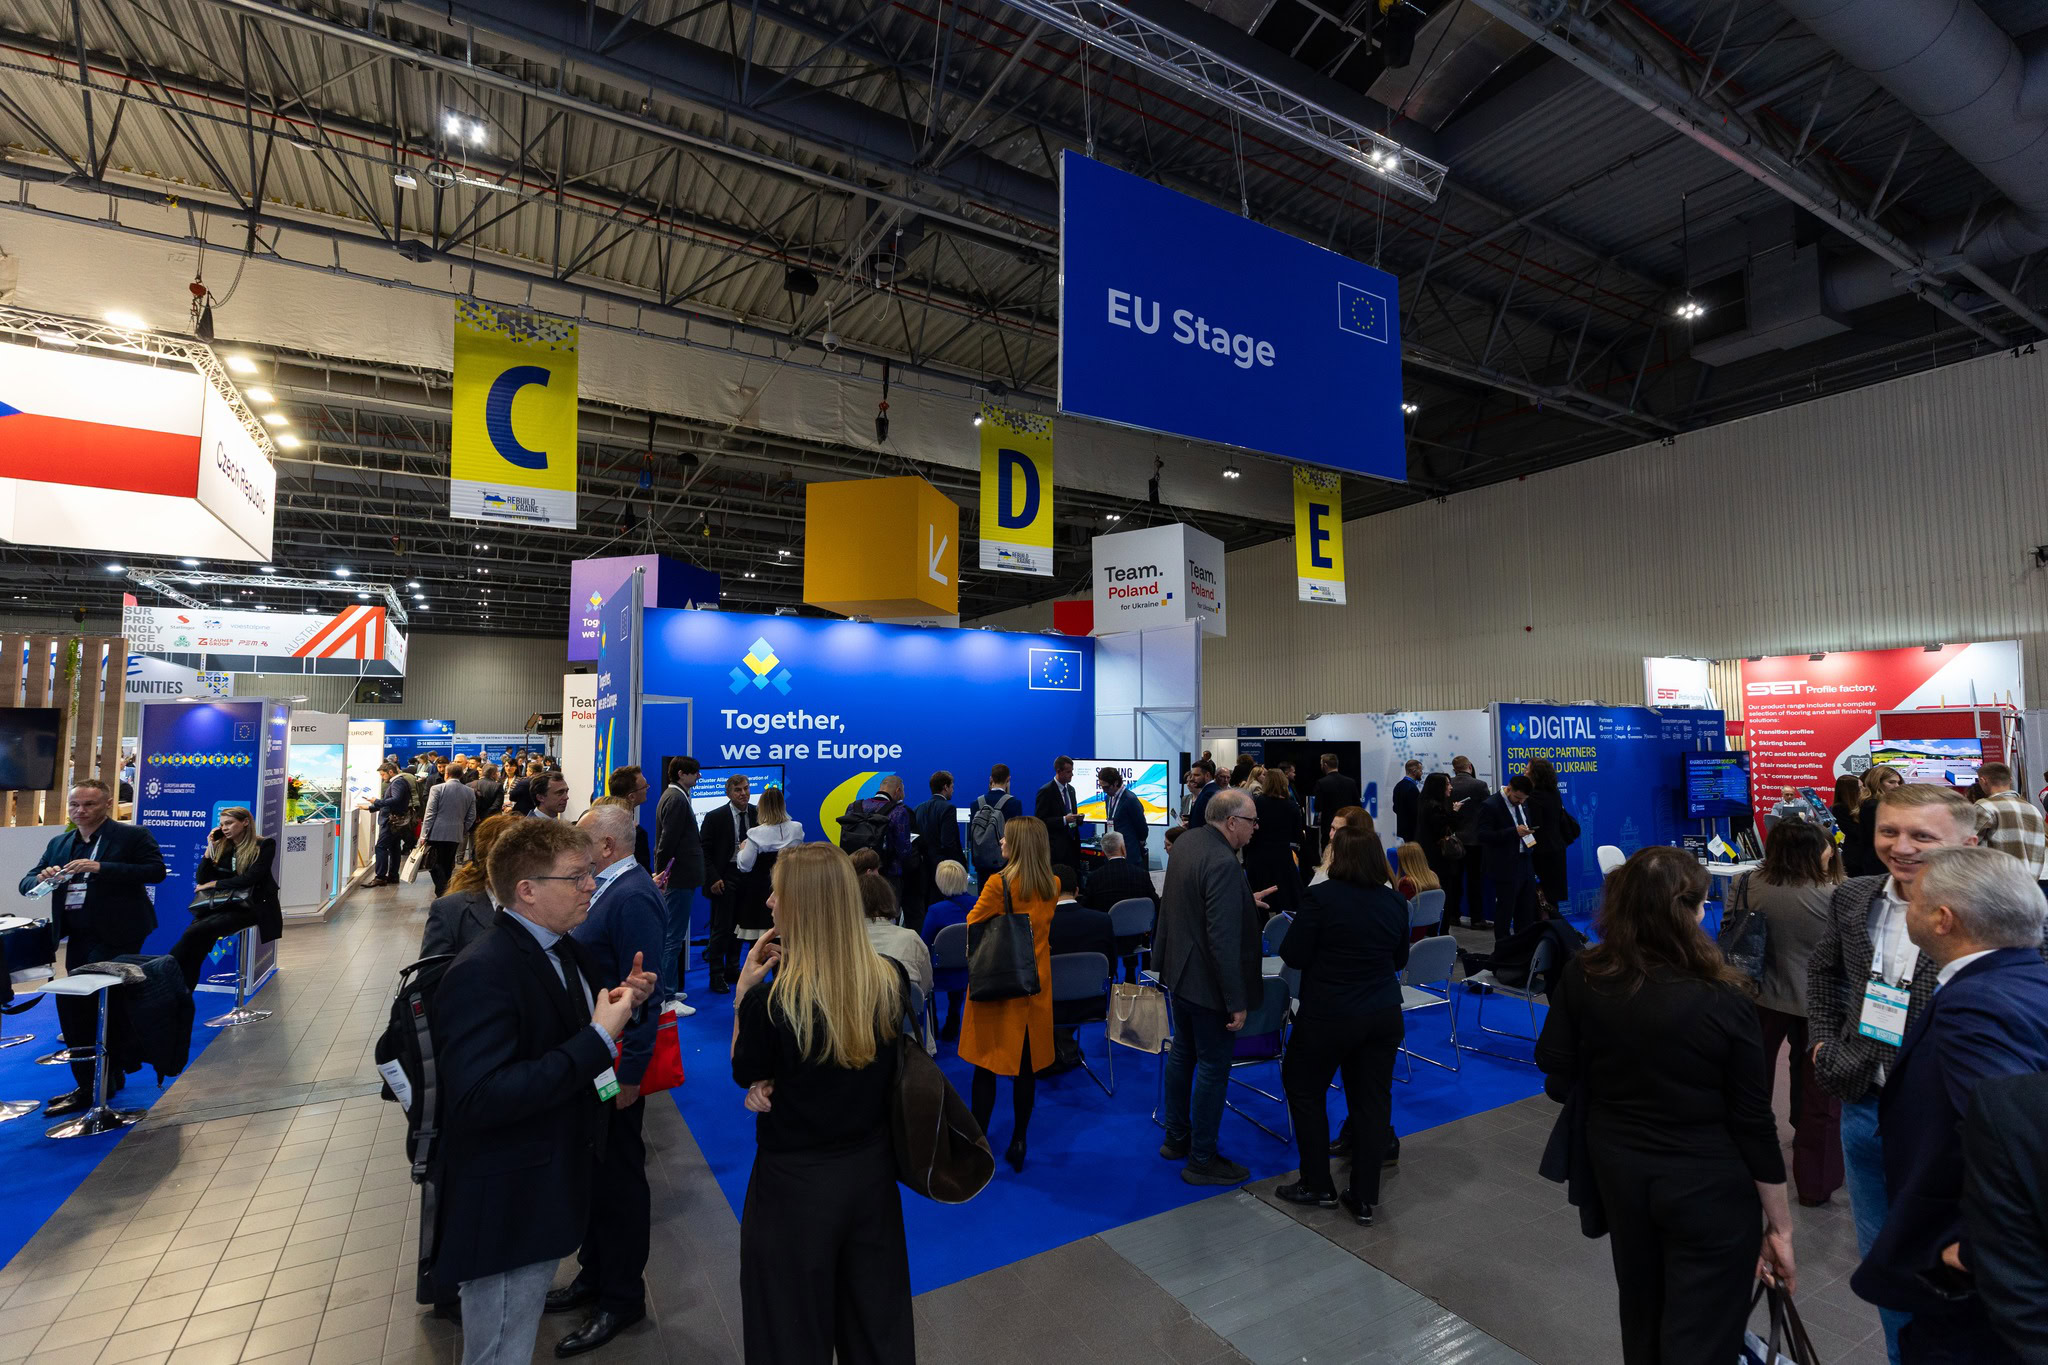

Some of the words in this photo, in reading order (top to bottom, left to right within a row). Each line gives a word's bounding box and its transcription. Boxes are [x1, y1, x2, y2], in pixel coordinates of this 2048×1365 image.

[1108, 288, 1160, 334] EU
[1173, 309, 1276, 369] Stage
[486, 366, 551, 470] C
[216, 440, 239, 488] Czech
[240, 468, 266, 514] Republic
[998, 448, 1040, 530] D
[507, 496, 536, 506] REBUILD
[512, 504, 538, 513] UKRAINE
[1309, 502, 1332, 568] E
[1104, 564, 1163, 582] Team.
[1188, 560, 1216, 585] Team.
[1108, 582, 1158, 599] Poland
[1191, 582, 1214, 600] Poland
[124, 606, 152, 616] SUR
[1132, 600, 1159, 609] Ukraine
[124, 616, 154, 624] PRIS
[123, 625, 163, 634] INGLY
[284, 620, 324, 655] AUSTRIA
[1657, 688, 1679, 699] SET
[1746, 680, 1807, 696] SET
[1806, 686, 1837, 694] Profile
[1839, 685, 1877, 693] factory.
[721, 709, 845, 734] Together,
[1529, 716, 1596, 739] DIGITAL
[1261, 728, 1297, 736] PORTUGAL
[721, 744, 761, 760] we
[768, 743, 810, 760] are
[818, 740, 902, 763] Europe
[1508, 747, 1554, 759] STRATEGIC
[1556, 746, 1597, 758] PARTNERS
[1564, 761, 1598, 773] UKRAINE
